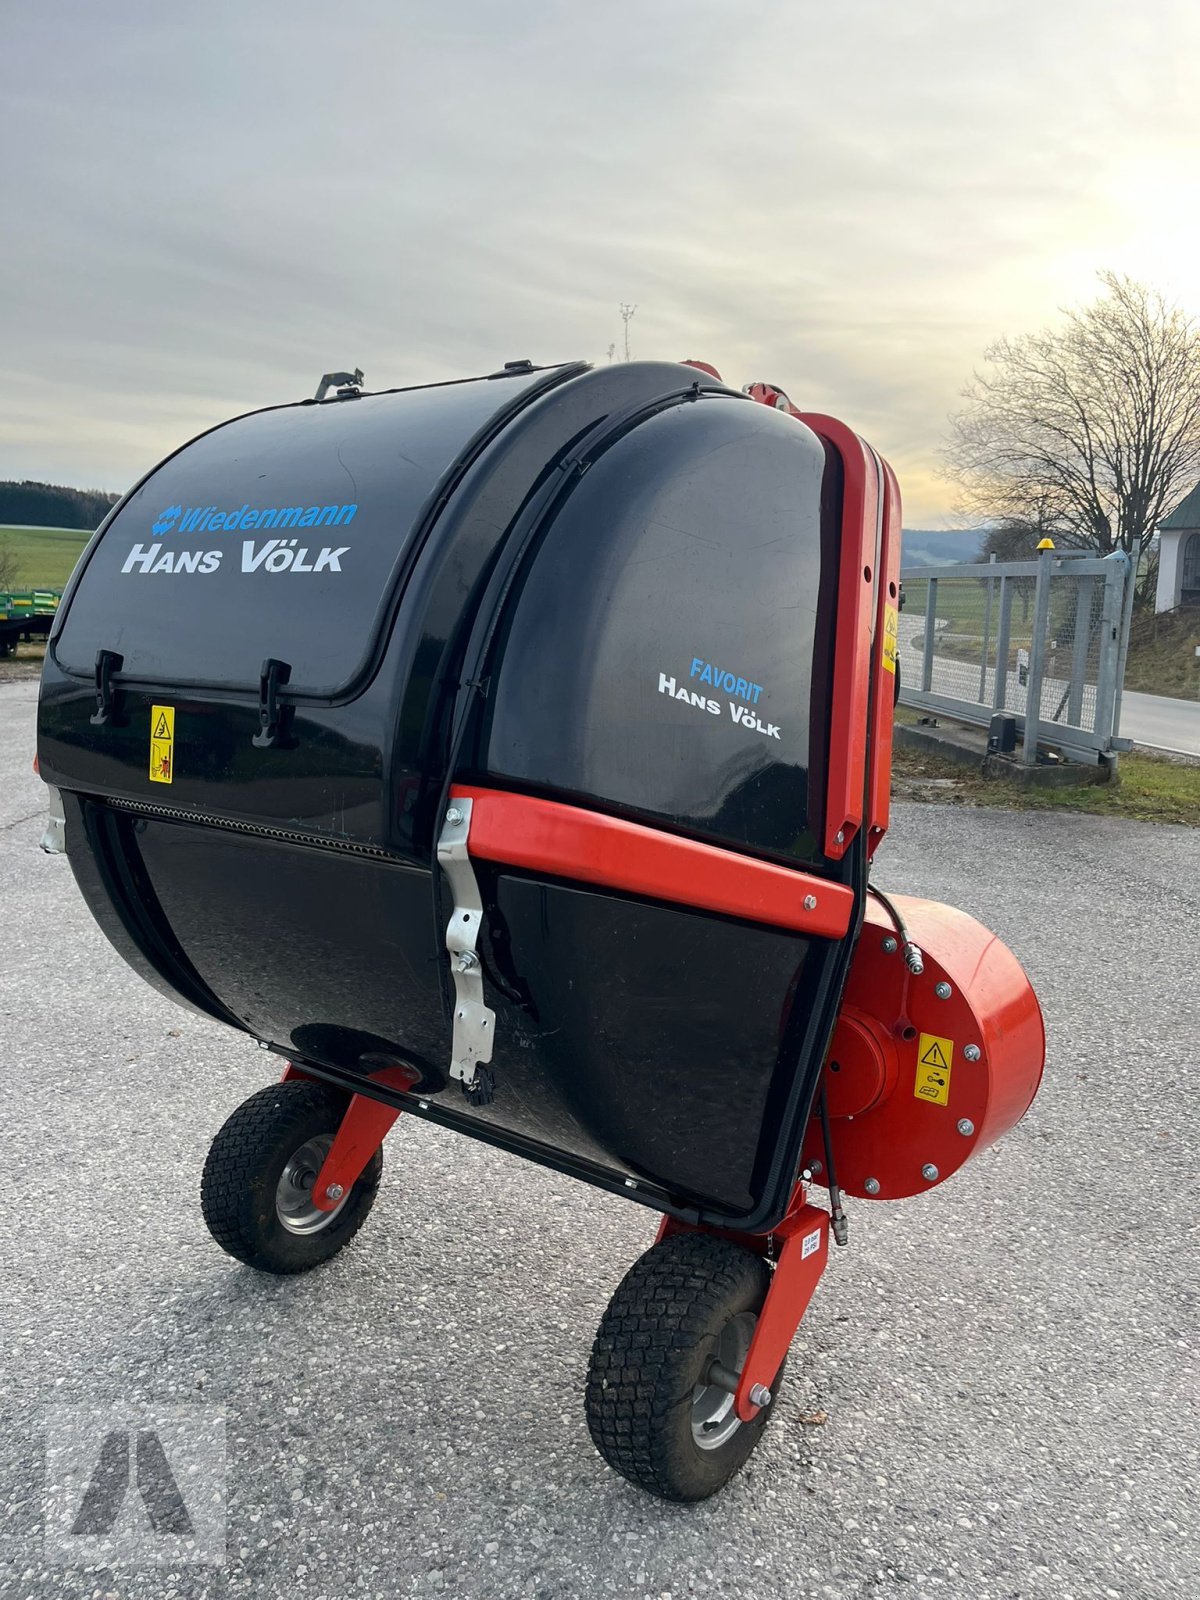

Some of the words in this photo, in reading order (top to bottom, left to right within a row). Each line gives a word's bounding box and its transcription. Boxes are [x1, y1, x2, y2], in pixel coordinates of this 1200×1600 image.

[178, 504, 358, 532] Wiedenmann
[121, 543, 223, 574] HANS
[241, 539, 351, 573] VÖLK
[690, 657, 763, 704] FAVORIT
[658, 672, 721, 715] HANS
[729, 701, 781, 740] VÖLK
